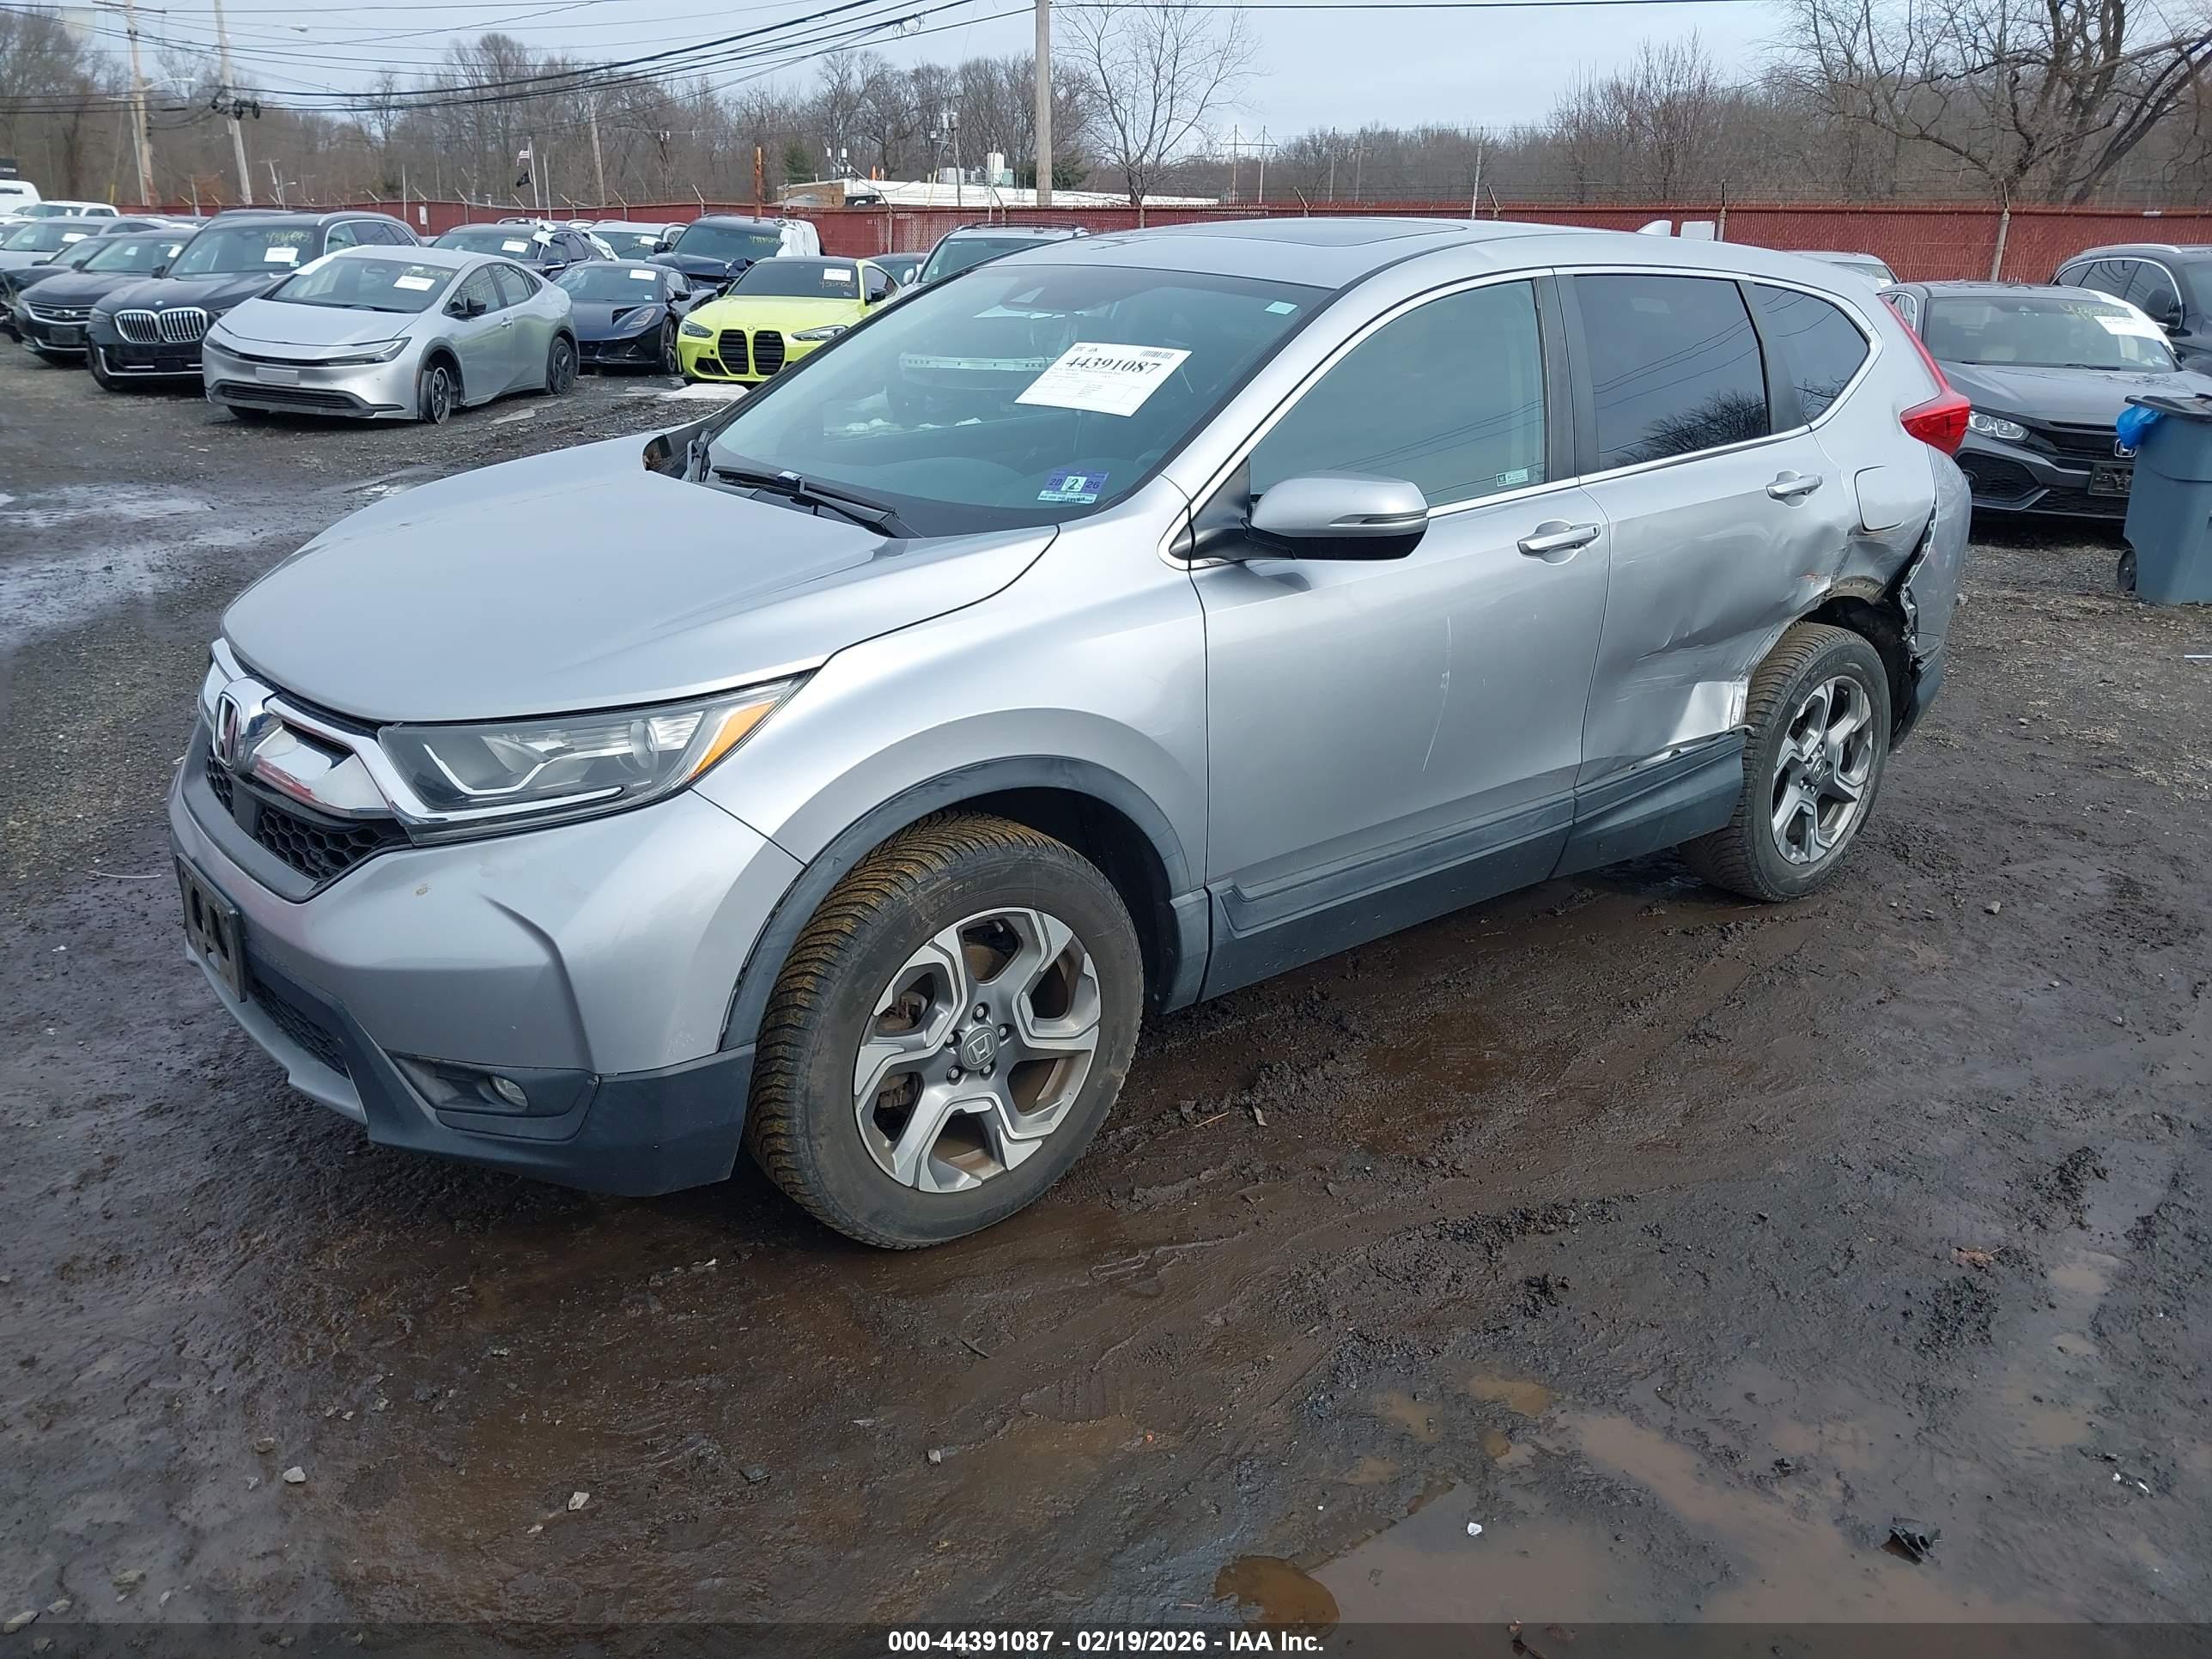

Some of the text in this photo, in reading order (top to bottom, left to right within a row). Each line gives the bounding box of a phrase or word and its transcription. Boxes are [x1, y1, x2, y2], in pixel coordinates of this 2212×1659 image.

[1066, 356, 1162, 374] 44391087
[1048, 477, 1101, 490] 20 2 26
